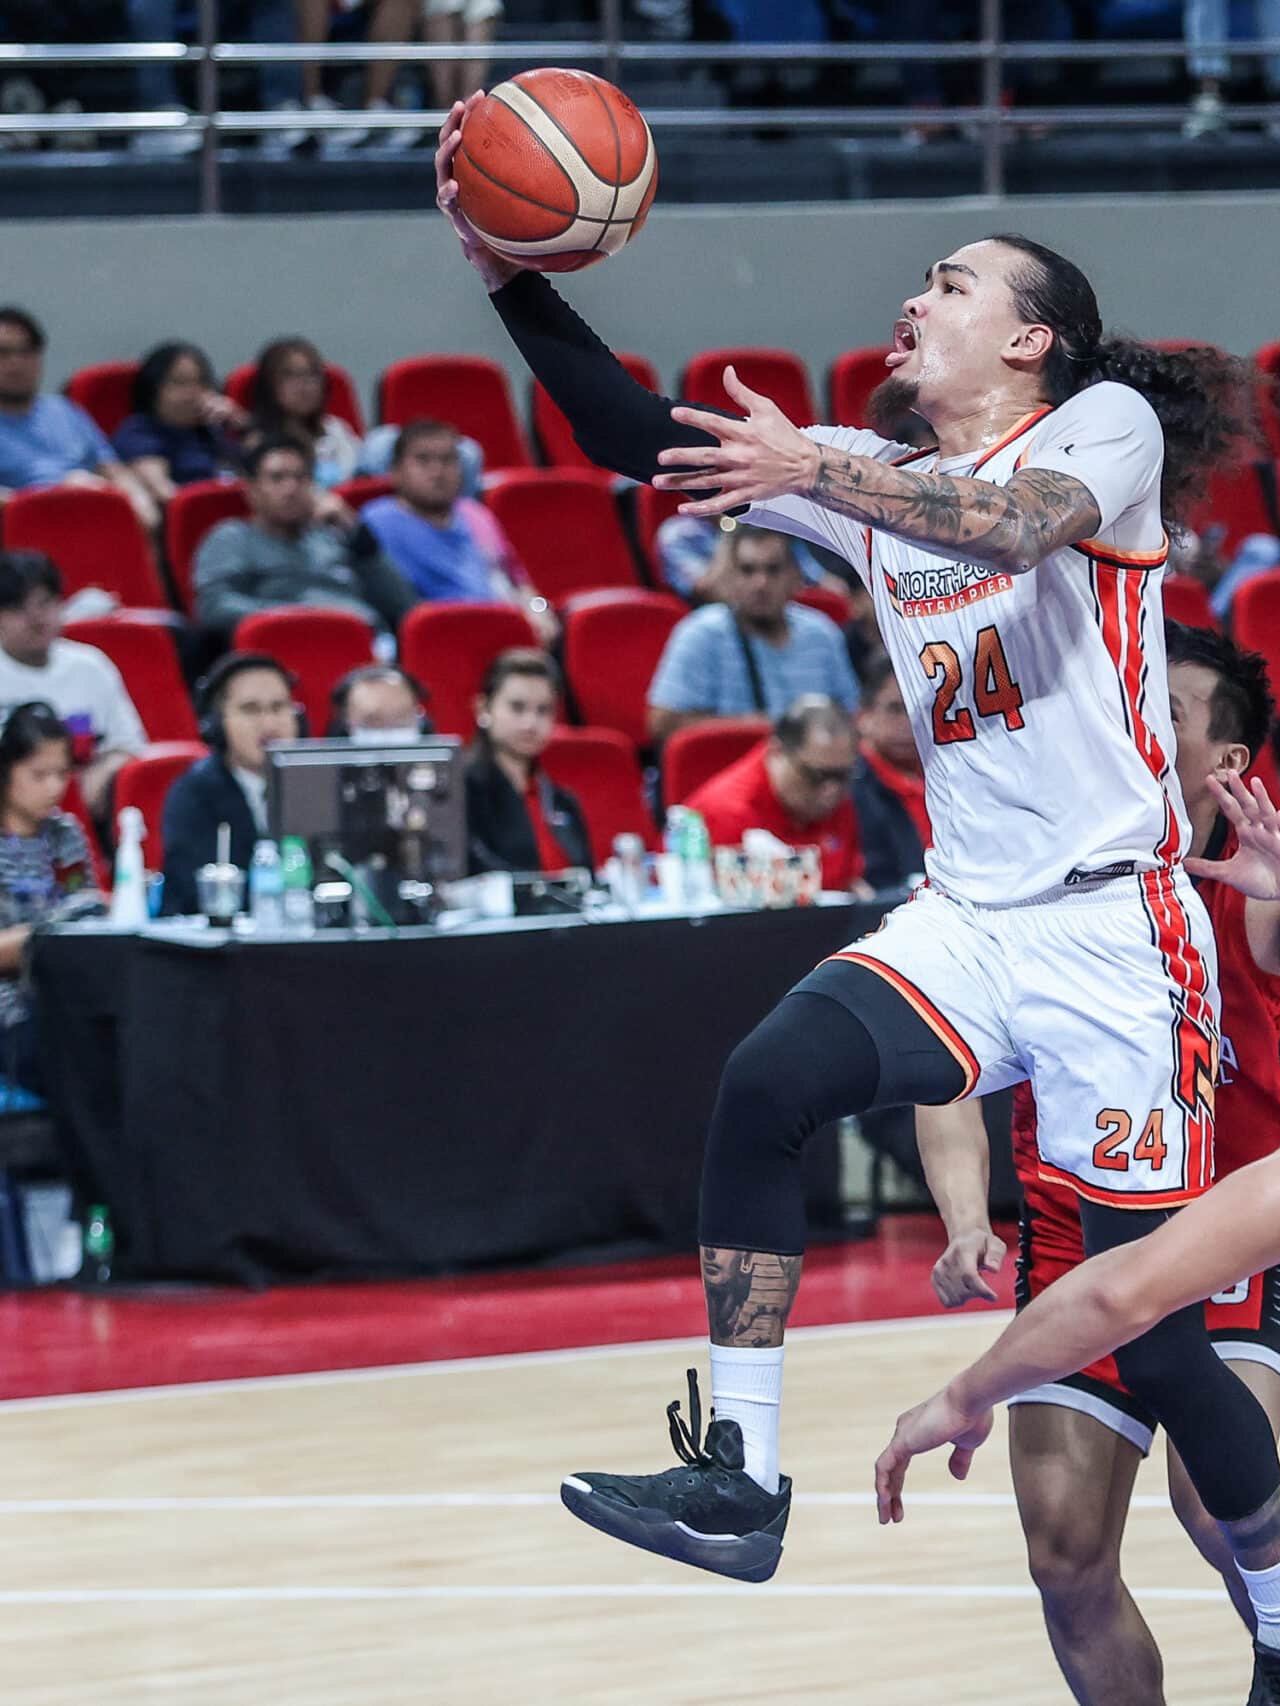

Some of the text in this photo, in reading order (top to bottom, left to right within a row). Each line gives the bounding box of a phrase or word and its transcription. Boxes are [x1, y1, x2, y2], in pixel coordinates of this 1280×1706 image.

[898, 561, 998, 600] NORTHPO
[967, 576, 1010, 601] PIER
[919, 624, 1025, 745] 24
[1093, 1108, 1167, 1172] 24
